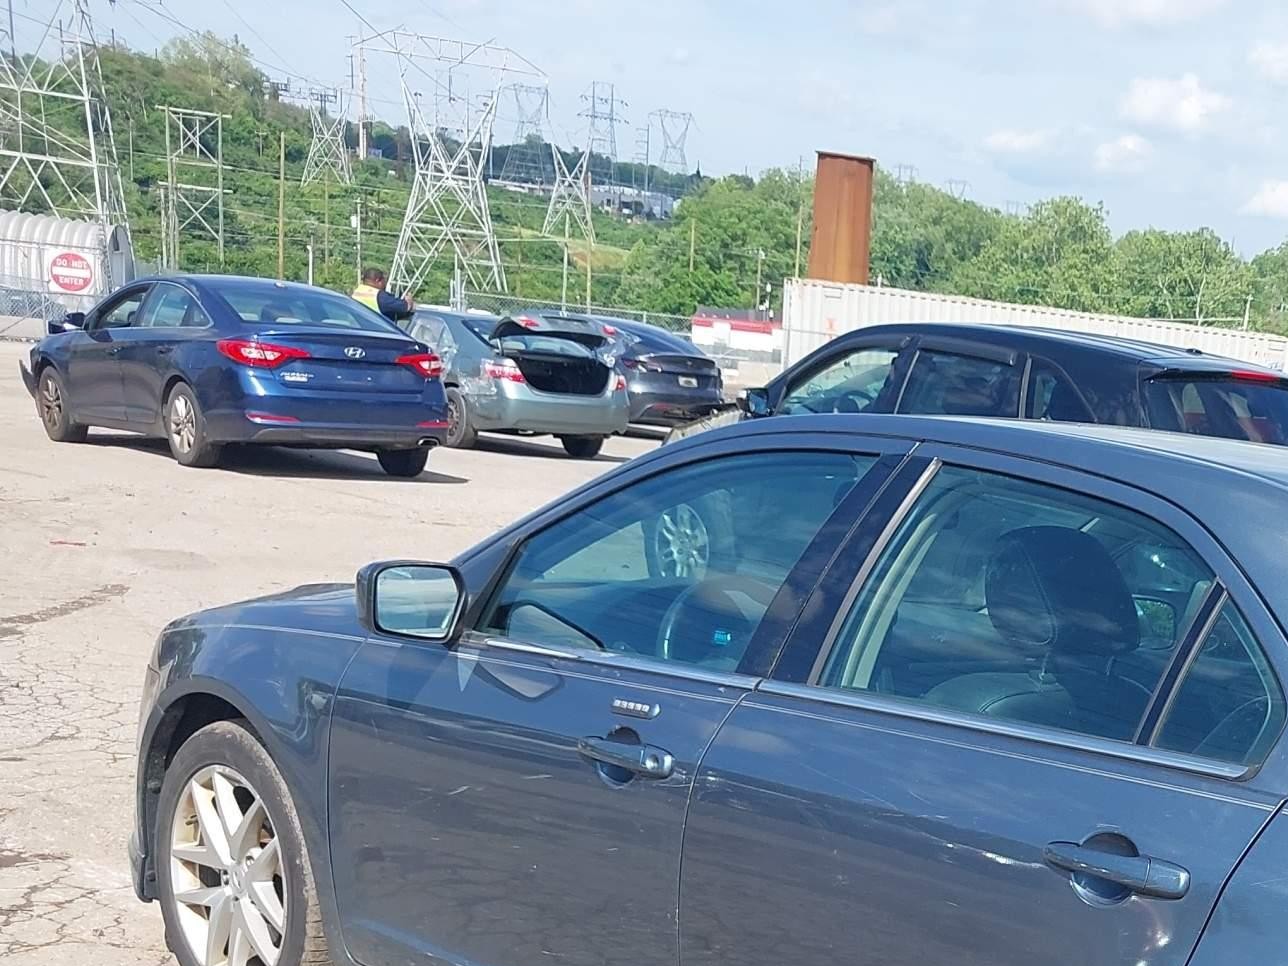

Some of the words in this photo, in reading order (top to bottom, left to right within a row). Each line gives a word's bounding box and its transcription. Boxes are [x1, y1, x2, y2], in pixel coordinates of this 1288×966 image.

[56, 258, 67, 266] DO
[71, 260, 87, 268] NOT
[58, 276, 84, 286] ENTER
